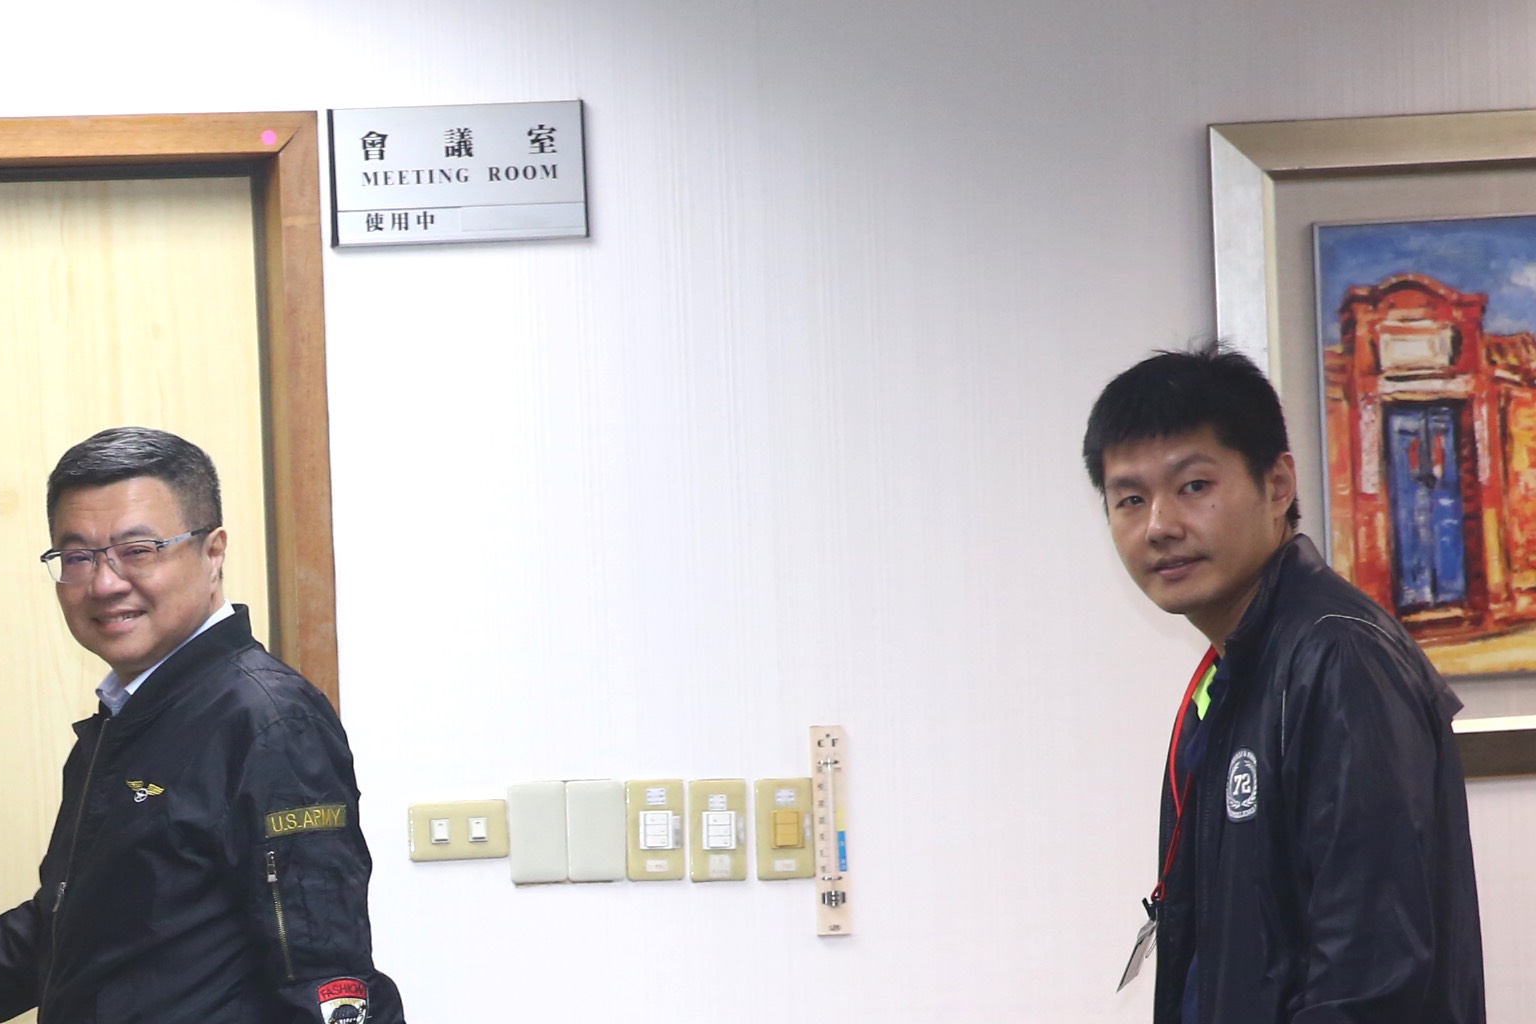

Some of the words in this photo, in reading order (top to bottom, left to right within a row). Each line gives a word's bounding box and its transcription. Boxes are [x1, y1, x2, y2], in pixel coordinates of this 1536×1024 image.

[361, 124, 557, 161] 會議室
[361, 167, 469, 186] MEETING
[488, 164, 558, 182] ROOM
[366, 211, 435, 232] 使用中
[1232, 773, 1251, 796] 72
[319, 983, 366, 1000] FASHION
